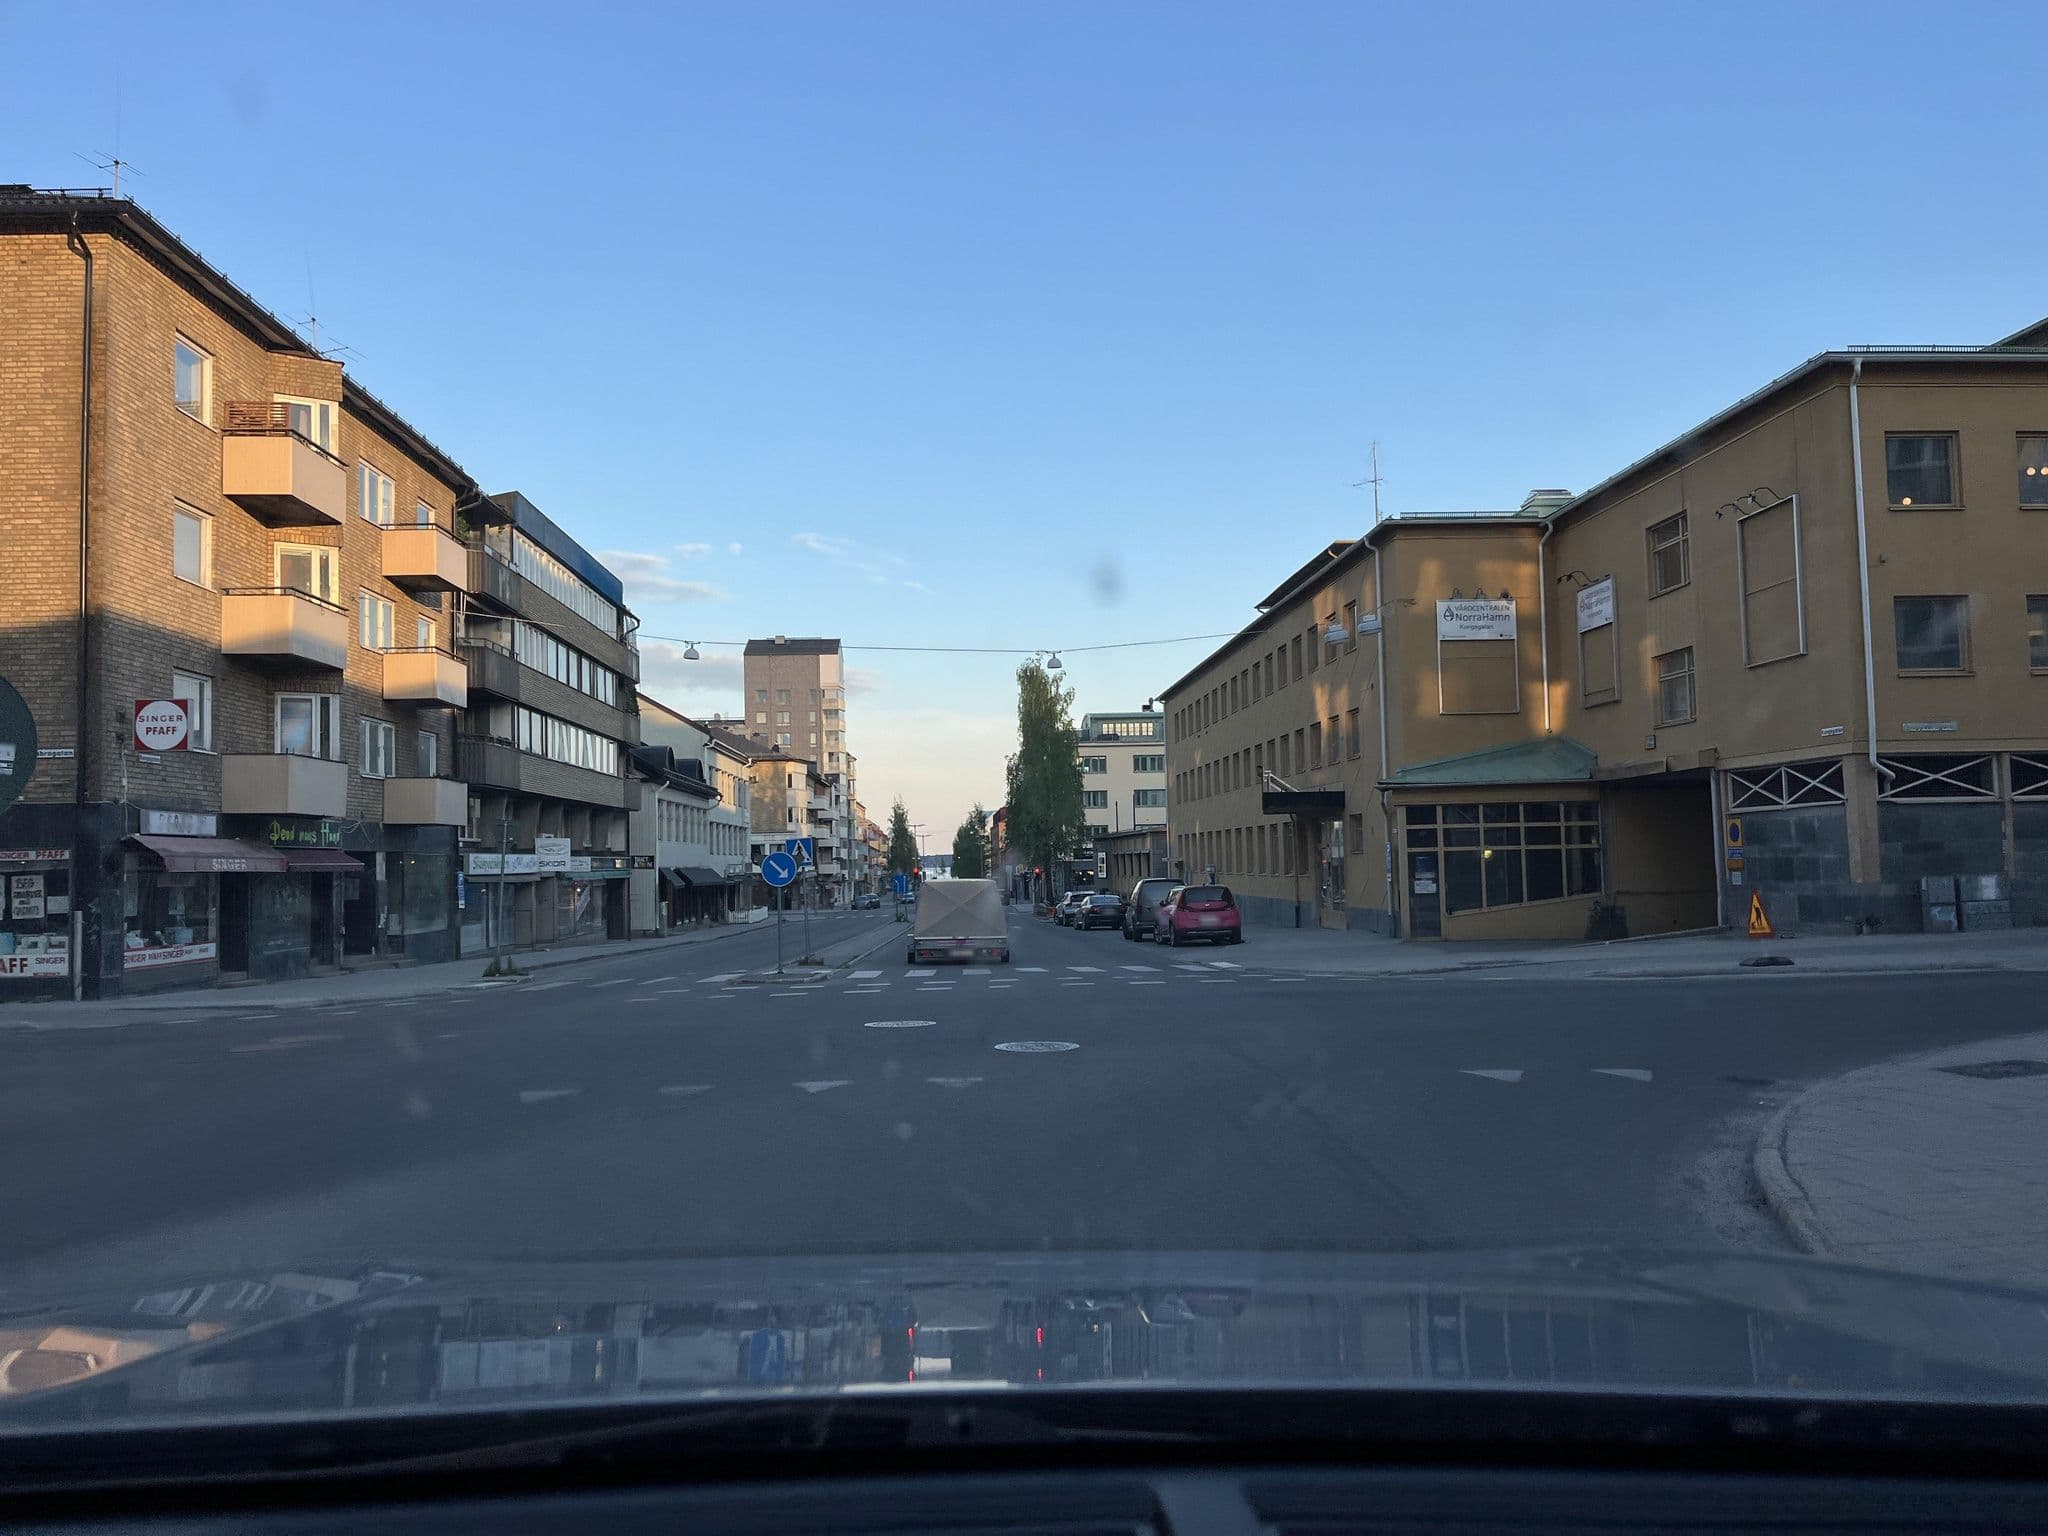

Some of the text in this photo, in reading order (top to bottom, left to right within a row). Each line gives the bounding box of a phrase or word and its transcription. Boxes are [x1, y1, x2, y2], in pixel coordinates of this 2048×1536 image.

[1454, 603, 1510, 612] VÅRDCENTRALEN
[1455, 613, 1510, 621] NorraHamn
[138, 715, 184, 723] SINGER
[145, 726, 177, 735] PFAFF
[0, 849, 65, 860] INGER PFAFF
[211, 858, 247, 871] SINGER
[162, 949, 185, 960] SINGER
[0, 957, 66, 974] AFF SINGER
